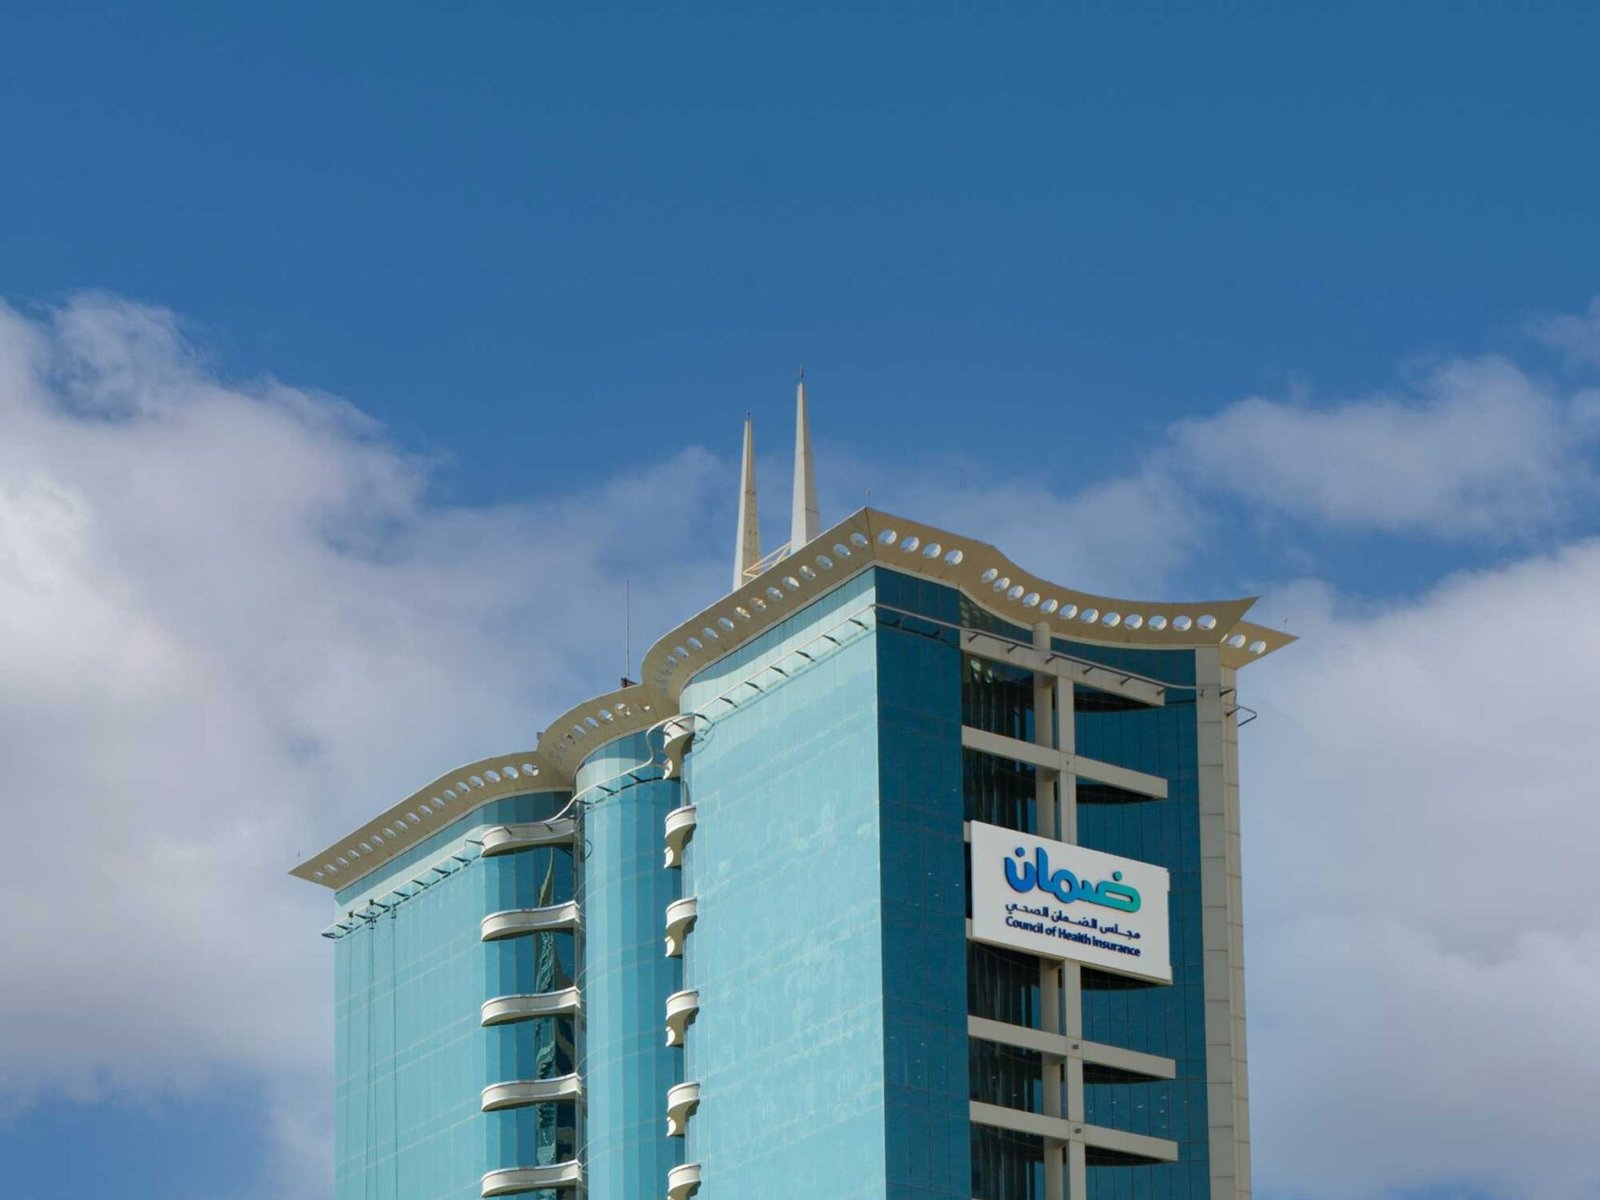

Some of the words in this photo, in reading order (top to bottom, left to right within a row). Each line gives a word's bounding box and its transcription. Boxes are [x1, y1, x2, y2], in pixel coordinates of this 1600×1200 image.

[1004, 847, 1142, 913] ضمان
[1005, 903, 1049, 918] الصحي
[1051, 909, 1098, 930] الضمان
[1005, 915, 1044, 935] Council
[1045, 925, 1058, 937] of
[1057, 927, 1092, 946] Health
[1099, 923, 1141, 940] مجلس
